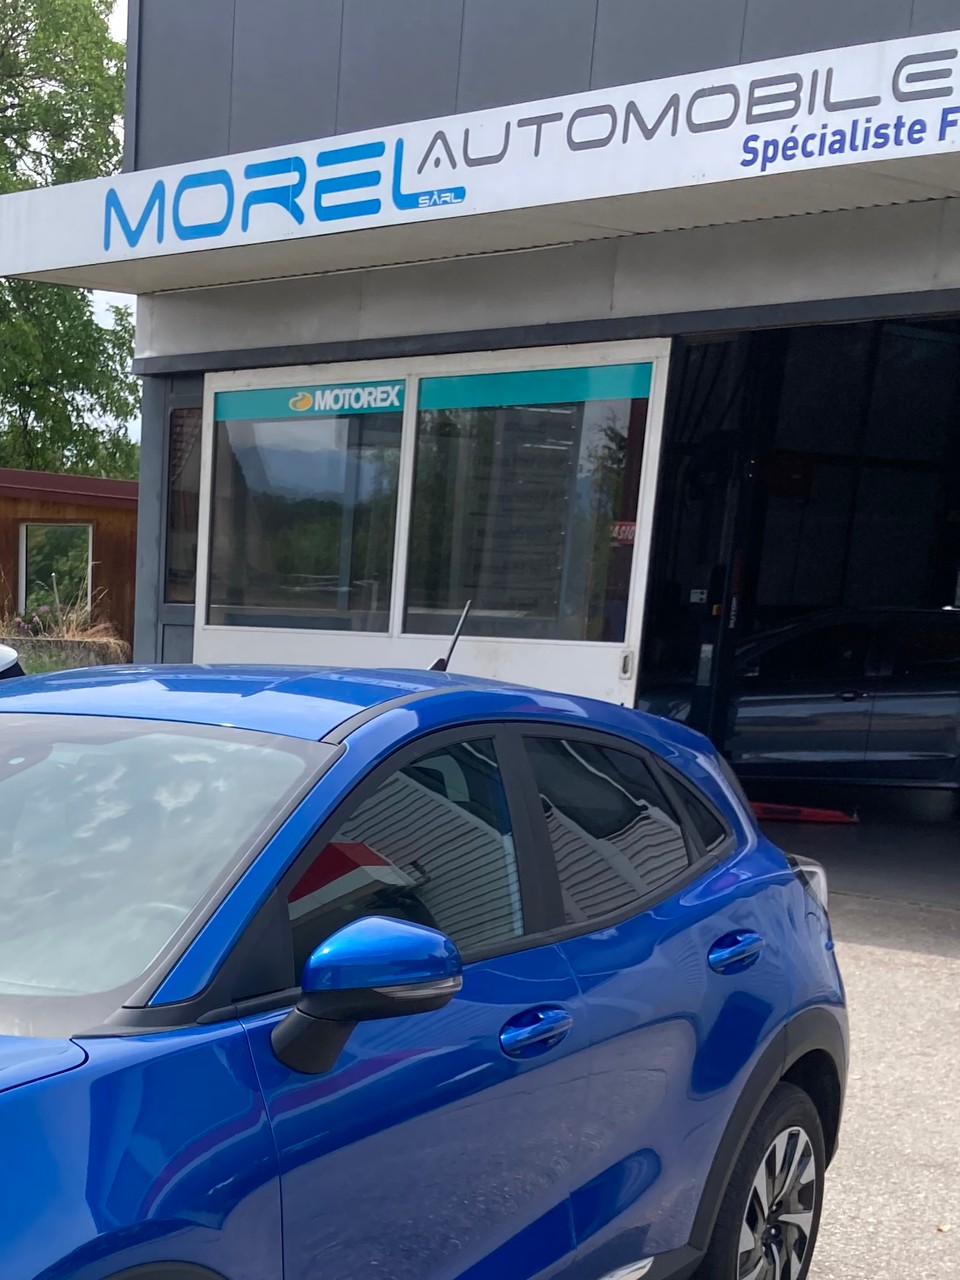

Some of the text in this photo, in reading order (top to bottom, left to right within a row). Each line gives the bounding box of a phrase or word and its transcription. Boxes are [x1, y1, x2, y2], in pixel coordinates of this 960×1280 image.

[416, 48, 959, 175] AUTOMOBILE
[740, 114, 927, 172] Spécialiste
[103, 136, 467, 251] MOREL
[314, 385, 402, 411] MOTOREX
